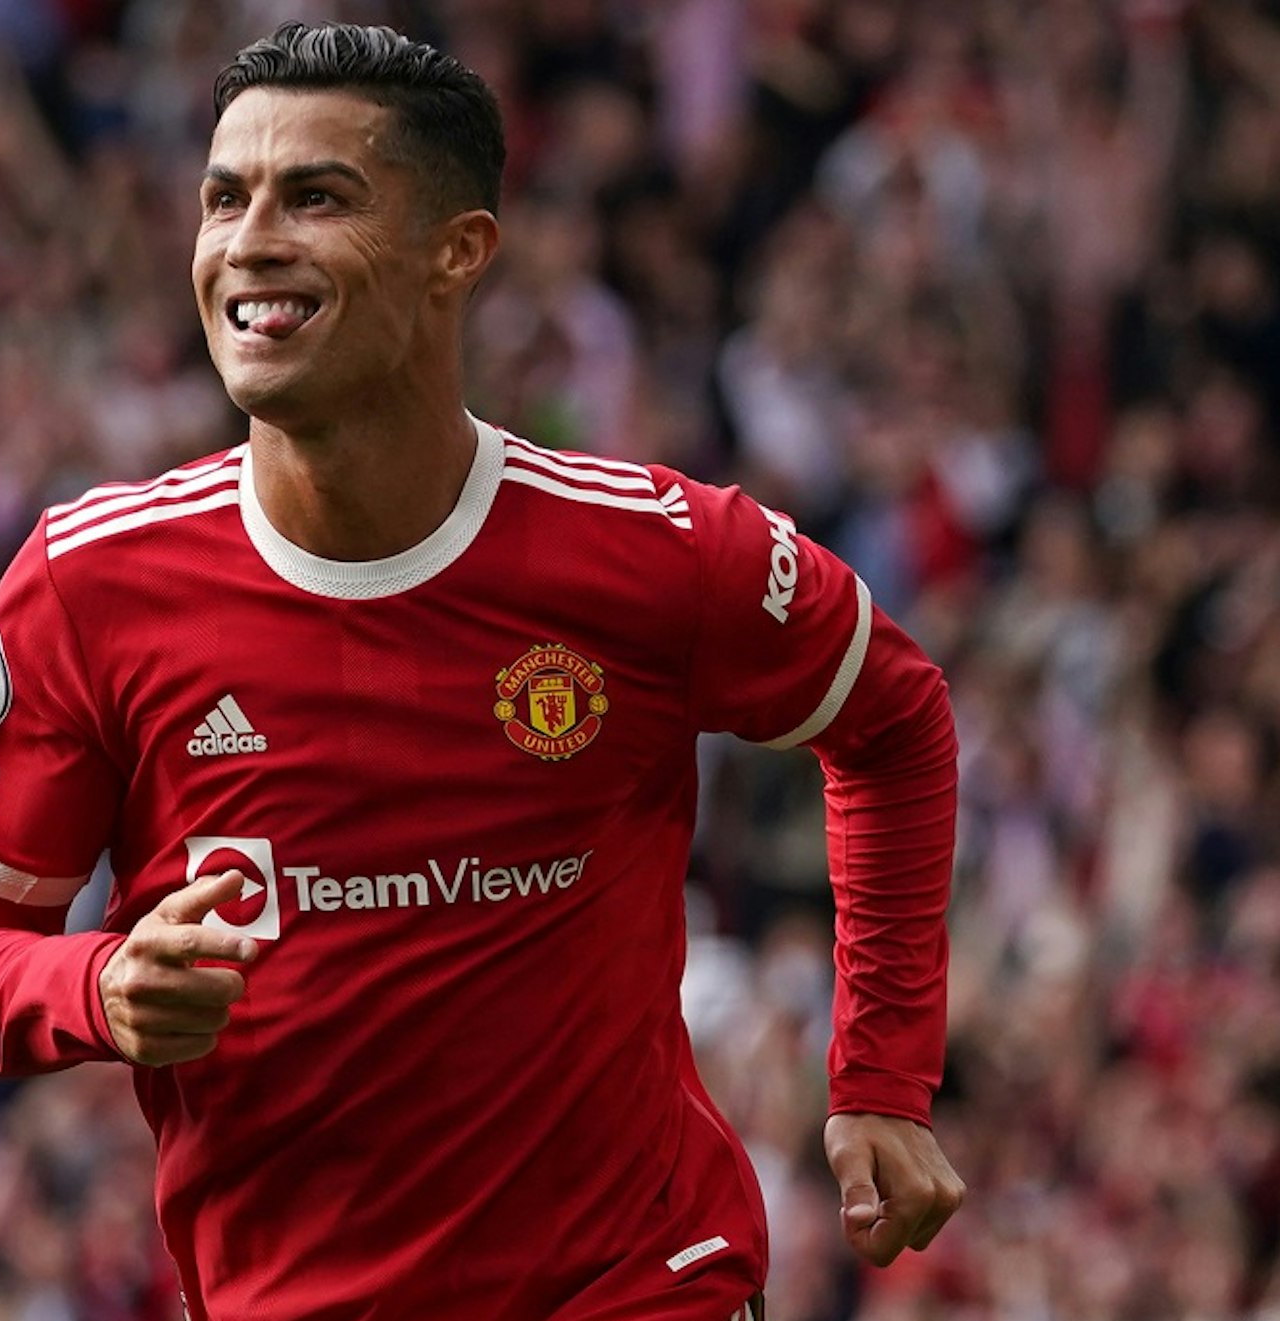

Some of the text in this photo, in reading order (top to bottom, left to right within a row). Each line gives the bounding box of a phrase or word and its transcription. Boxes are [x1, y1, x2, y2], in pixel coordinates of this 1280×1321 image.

[504, 652, 598, 693] MANCHESTER
[186, 731, 269, 758] adidas
[523, 730, 588, 753] UNITED
[282, 849, 594, 913] TeamViewer
